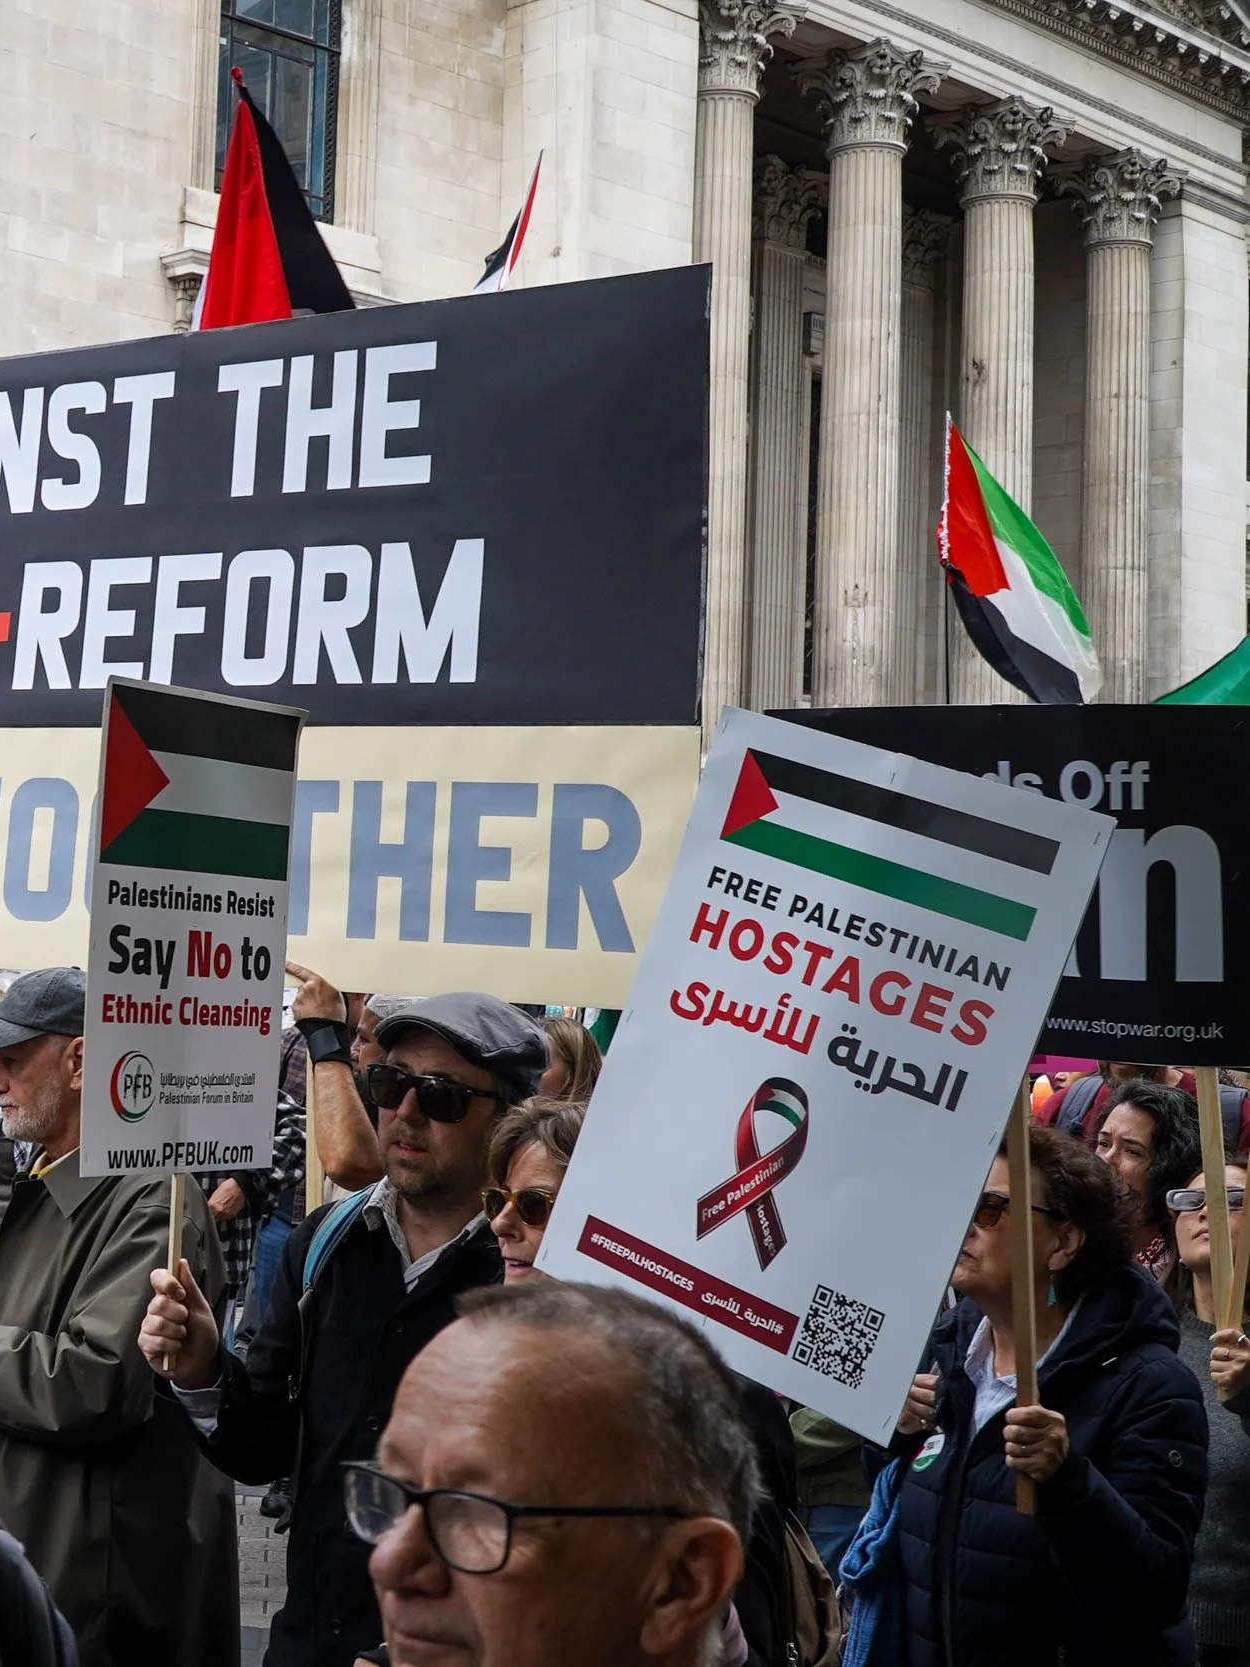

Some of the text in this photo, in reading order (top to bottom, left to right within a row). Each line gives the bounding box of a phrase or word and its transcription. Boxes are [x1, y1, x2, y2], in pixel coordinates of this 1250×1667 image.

[217, 341, 437, 497] THE
[11, 538, 485, 690] REFORM
[1058, 759, 1150, 811] Off
[107, 879, 275, 918] Palestinians Resist
[706, 865, 1012, 992] FREE PALESTINIAN
[108, 923, 272, 990] Say No to
[689, 902, 995, 1047] HOSTAGES
[102, 993, 272, 1036] Ethnic Cleansing
[1046, 1016, 1225, 1043] www.stopwar.org.uk
[669, 981, 969, 1113] الحرية للأسرى
[123, 1068, 153, 1104] PFB
[159, 1090, 254, 1104] Palestinian Forum in Britain
[107, 1140, 254, 1169] www.PFBUK.com
[701, 1156, 785, 1222] Free Palestinian
[590, 1232, 695, 1292] #FREEPALHOSTAGES
